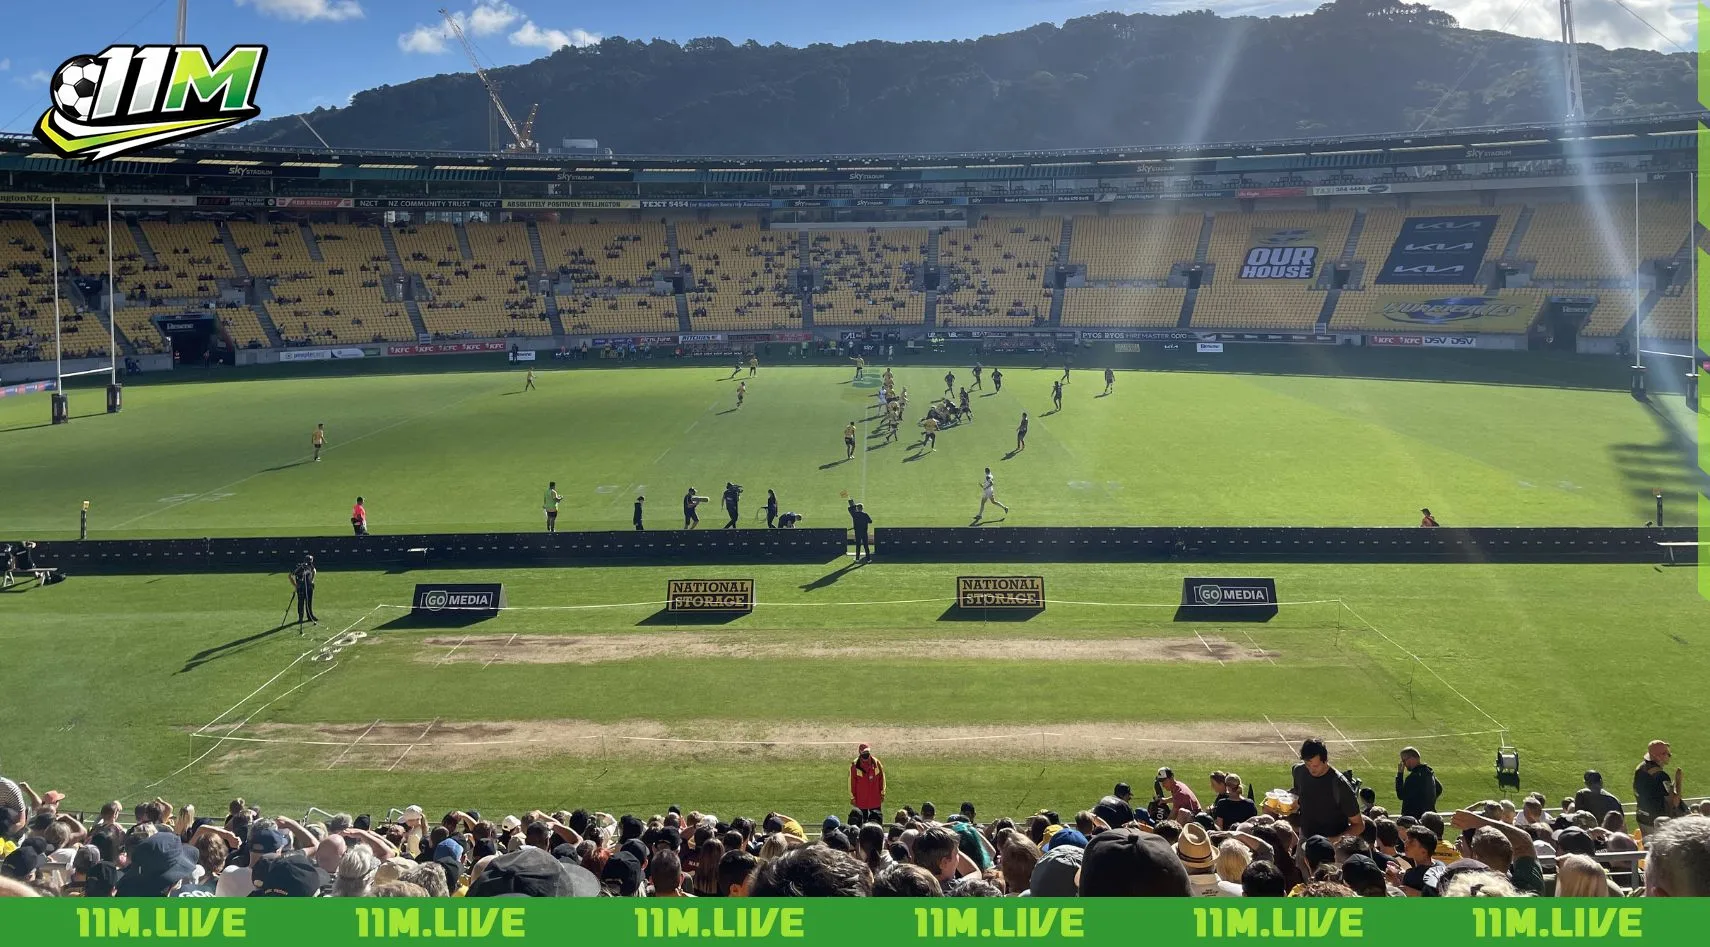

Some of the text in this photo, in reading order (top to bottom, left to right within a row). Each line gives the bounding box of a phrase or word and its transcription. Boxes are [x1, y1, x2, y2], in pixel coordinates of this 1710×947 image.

[228, 165, 247, 177] sky
[556, 171, 572, 181] sky
[849, 171, 864, 181] sky
[1247, 247, 1315, 266] OUR
[1241, 266, 1312, 278] HOUSE
[1378, 336, 1394, 344] KFC
[1425, 336, 1473, 345] DSV DSV
[673, 581, 748, 593] NATIONAL
[963, 579, 1039, 590] NATIONAL
[427, 594, 488, 607] GO MEDIA
[967, 591, 1037, 605] STORAGE
[1201, 589, 1265, 600] GO MEDIA
[675, 594, 745, 608] STORAGE
